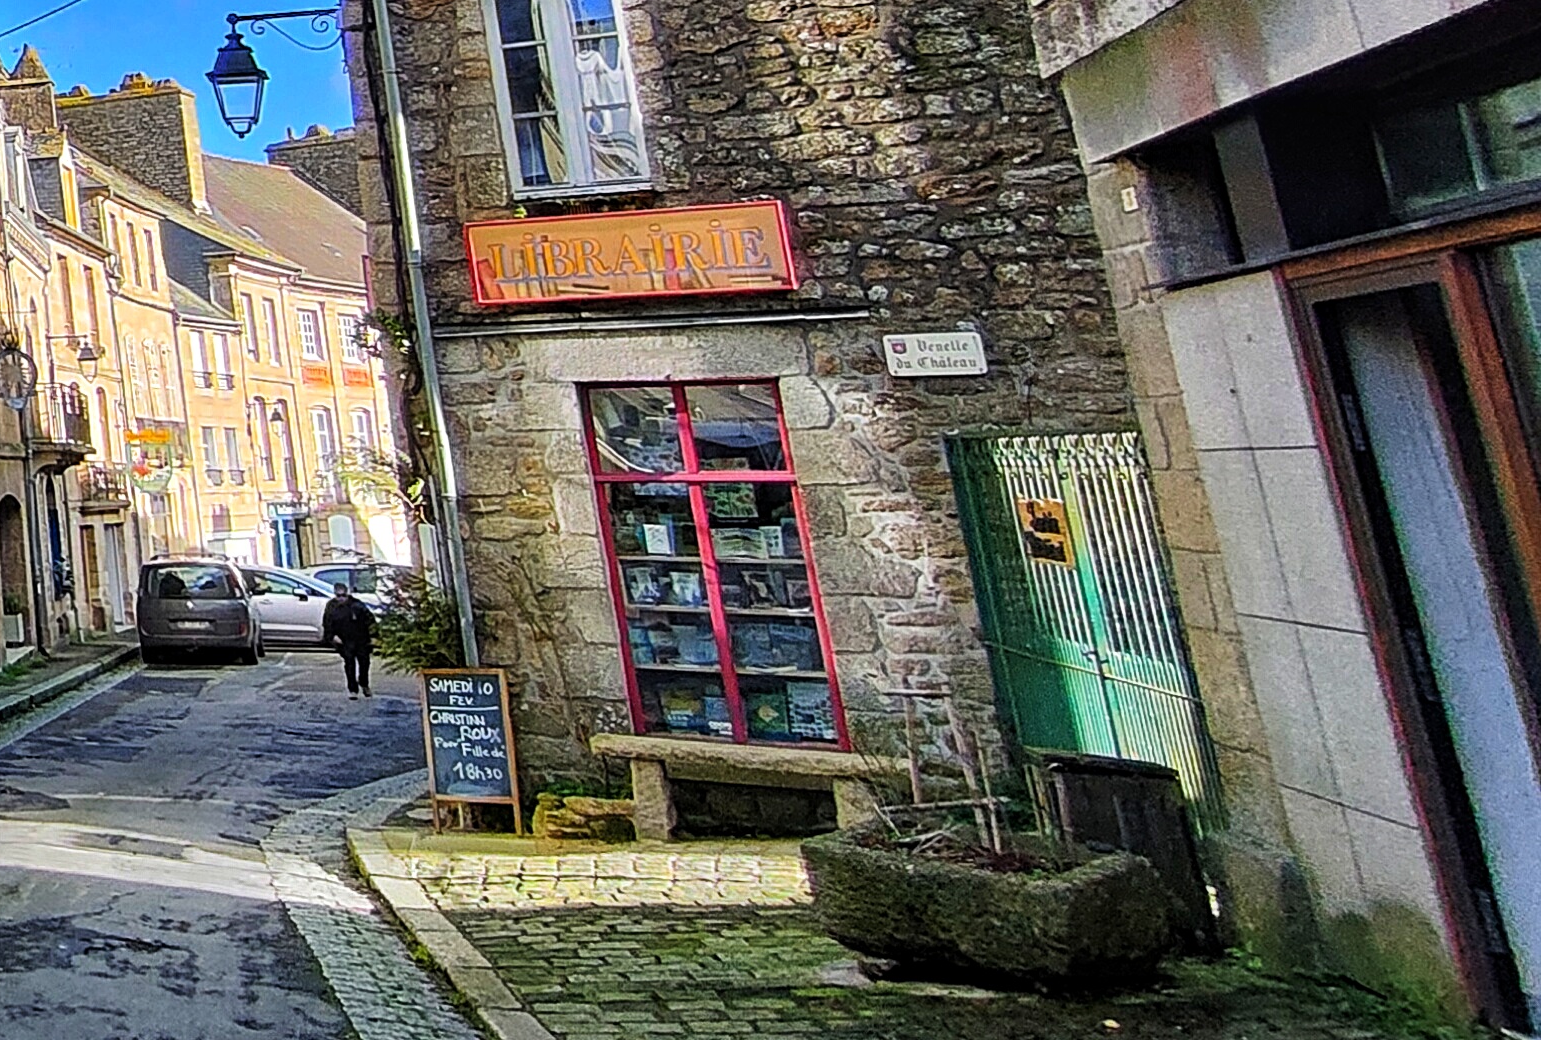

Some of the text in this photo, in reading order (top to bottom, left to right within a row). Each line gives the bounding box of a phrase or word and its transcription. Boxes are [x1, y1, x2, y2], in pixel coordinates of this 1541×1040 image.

[487, 218, 772, 282] LIBRAIRIE
[917, 339, 969, 353] Venelle
[896, 355, 977, 369] du Château
[429, 677, 494, 695] SAMEDI 10
[429, 710, 486, 726] CHRISTIAN
[433, 736, 458, 748] Pour
[459, 725, 502, 743] ROUX
[452, 761, 503, 781] 18h30
